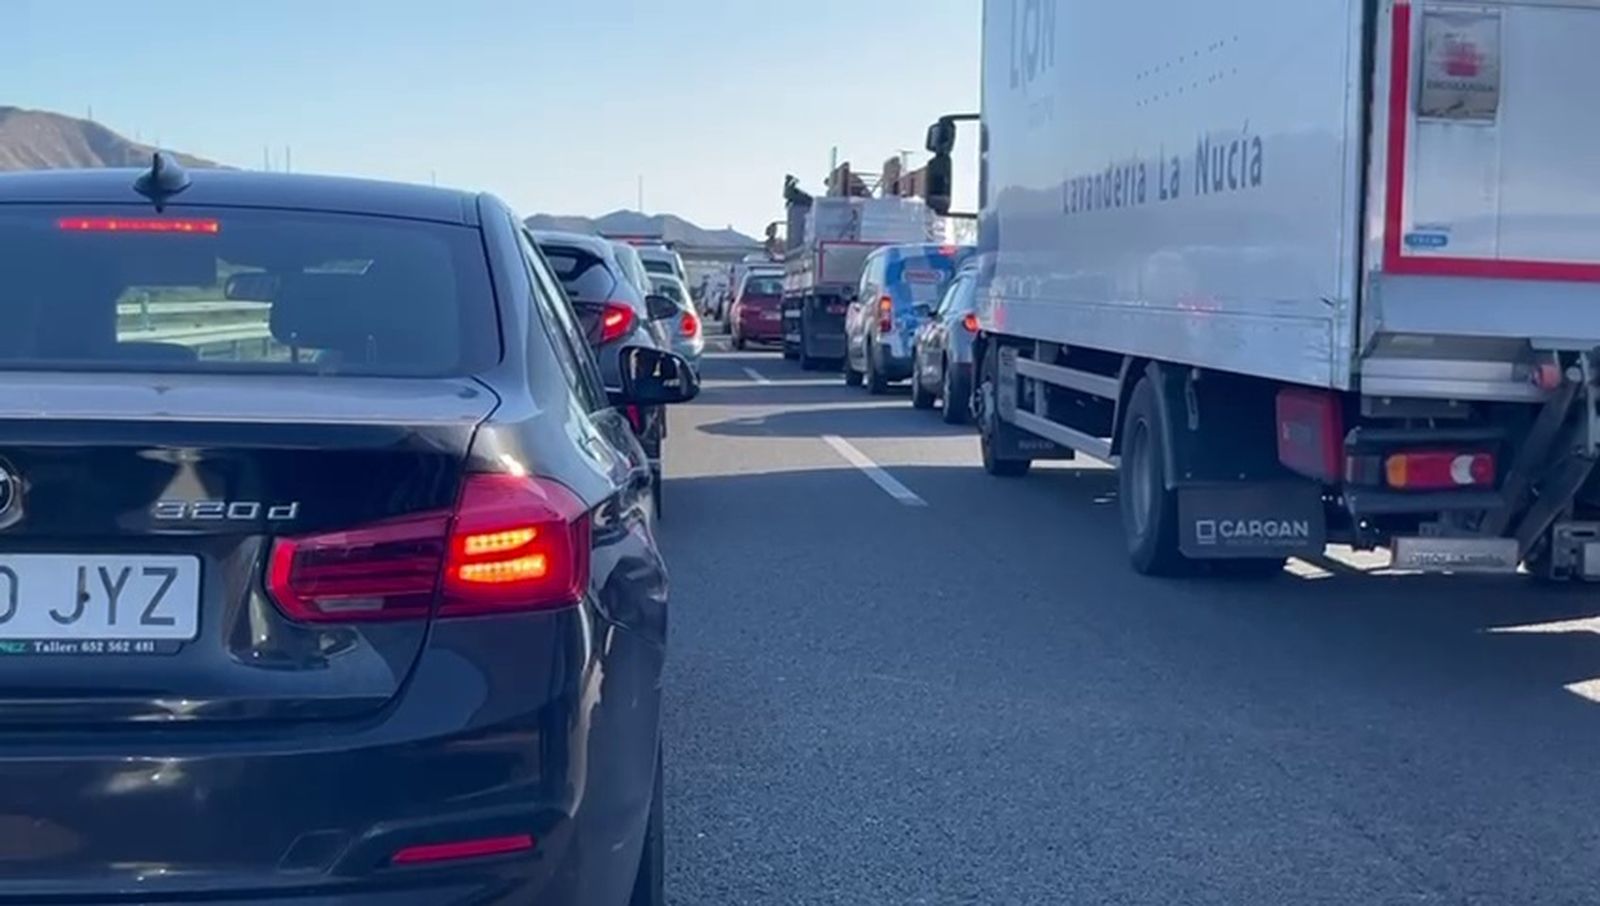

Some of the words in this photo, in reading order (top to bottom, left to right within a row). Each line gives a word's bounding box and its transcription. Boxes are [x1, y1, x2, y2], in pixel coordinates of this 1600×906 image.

[1159, 142, 1180, 201] La
[1195, 118, 1263, 196] Nucía
[1219, 520, 1309, 537] CARGAN
[49, 565, 179, 626] JYZ
